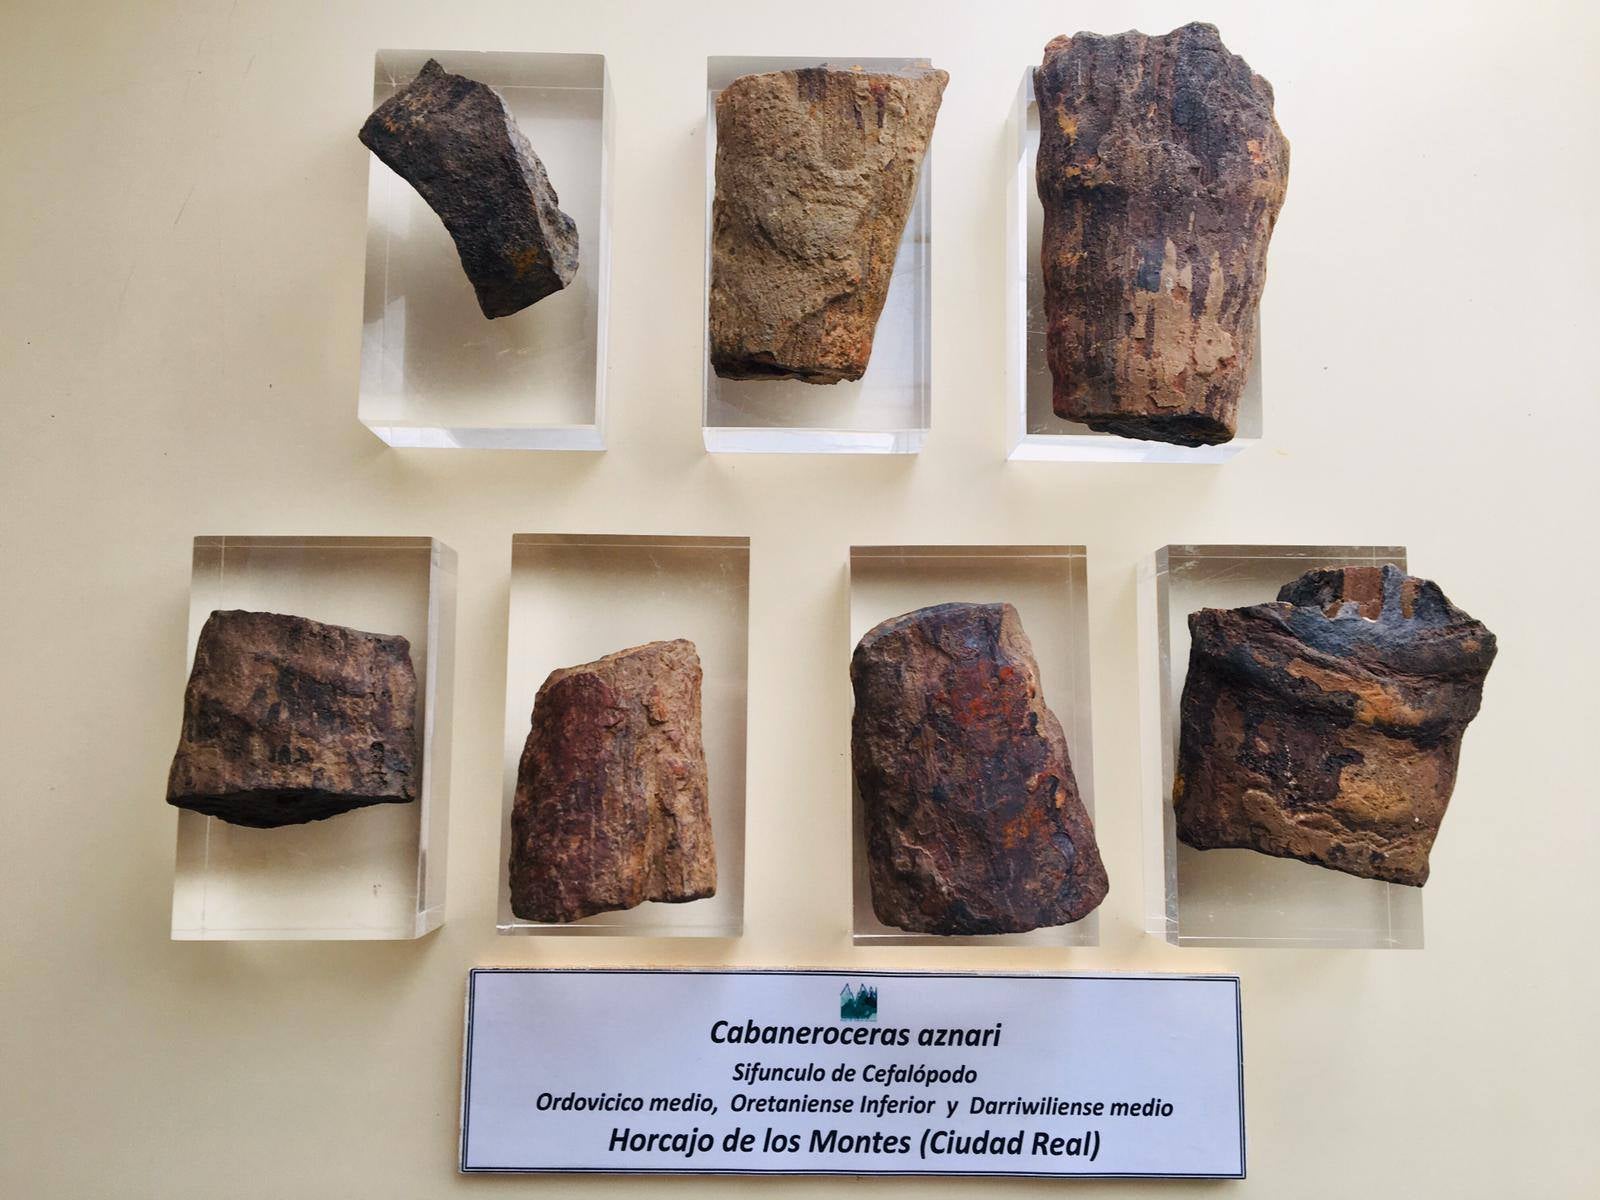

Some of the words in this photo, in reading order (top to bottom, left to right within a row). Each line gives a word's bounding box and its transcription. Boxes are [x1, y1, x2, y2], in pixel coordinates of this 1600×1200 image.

[710, 1019, 911, 1047] Cabaneroceras
[917, 1022, 1003, 1047] aznari
[732, 1061, 826, 1086] Sifunculo
[831, 1062, 857, 1083] de
[862, 1063, 978, 1088] Cefalópodo
[535, 1091, 644, 1112] Ordovicico
[648, 1092, 718, 1116] medio,
[730, 1093, 855, 1114] Oretaniense
[859, 1093, 937, 1118] Inferior
[945, 1100, 960, 1119] y
[969, 1096, 1105, 1117] Darriwiliense
[1109, 1097, 1174, 1118] medio
[608, 1126, 715, 1159] Horcajo
[722, 1126, 756, 1153] de
[762, 1127, 802, 1153] los
[808, 1129, 912, 1154] Montes
[919, 1128, 1025, 1160] (Ciudad
[1031, 1130, 1101, 1162] Real)
